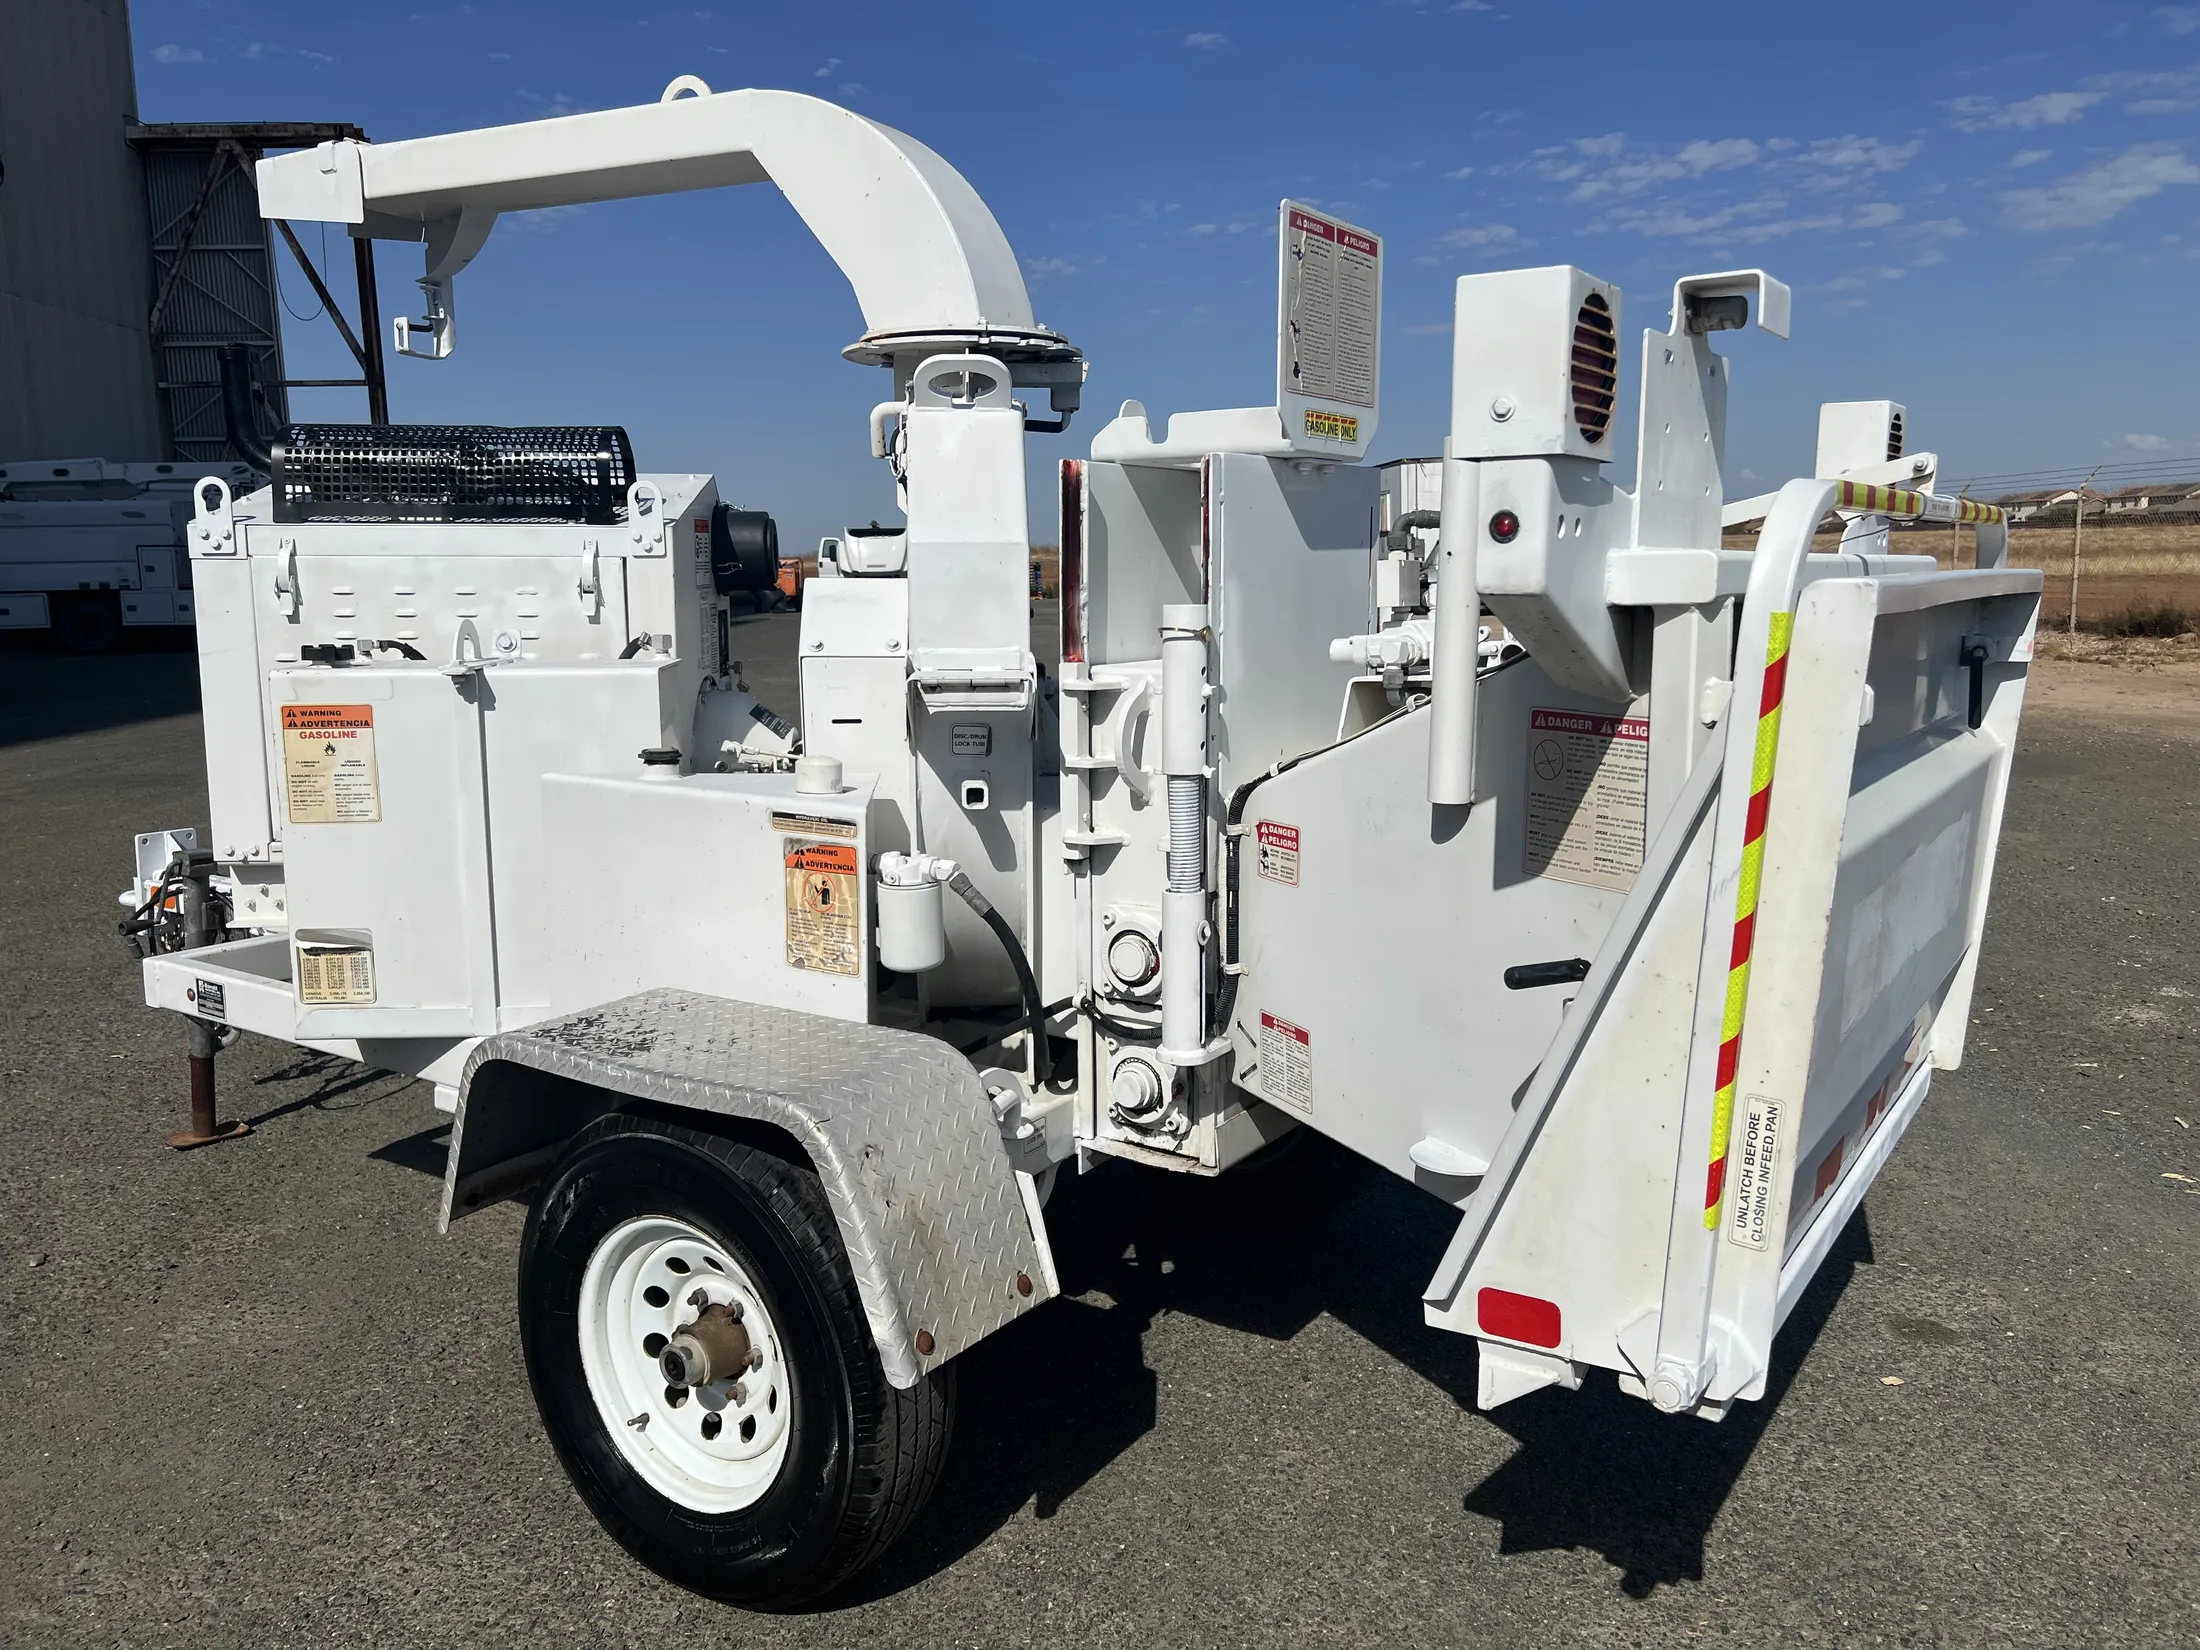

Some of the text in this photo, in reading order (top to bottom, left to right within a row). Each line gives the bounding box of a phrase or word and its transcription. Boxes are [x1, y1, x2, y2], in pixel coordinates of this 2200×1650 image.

[1349, 236, 1370, 250] PELIGRO
[1305, 420, 1357, 439] GASOLINE ONLY
[1548, 717, 1648, 737] DANGER PELIG
[299, 731, 358, 739] GASOLINE
[1269, 825, 1296, 838] DANGER
[1269, 836, 1297, 850] PELIGRO
[806, 848, 838, 856] WARNING
[805, 861, 854, 871] ADVERTENCIA
[1278, 1020, 1296, 1032] DANGER
[1278, 1026, 1296, 1038] PELIGRO
[1736, 1112, 1761, 1228] UNLATCH BEFORE
[1751, 1106, 1778, 1242] CLOSING INFEED PAN
